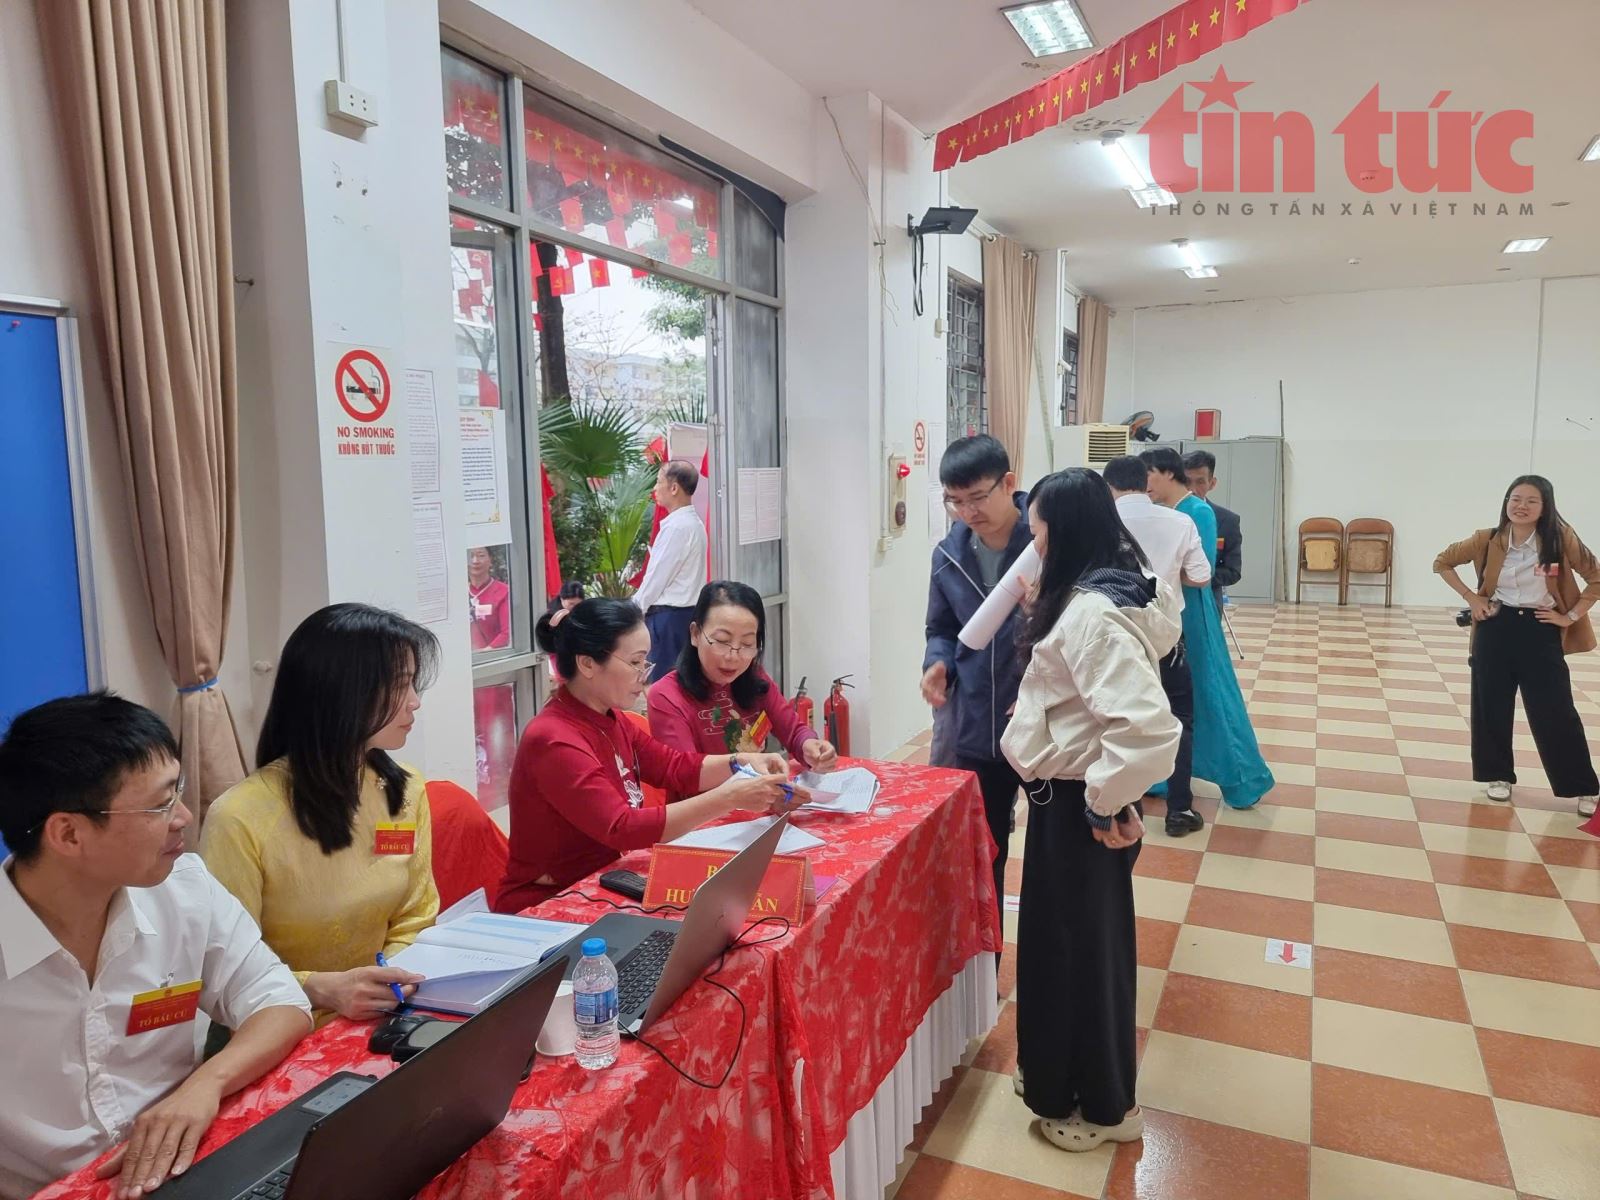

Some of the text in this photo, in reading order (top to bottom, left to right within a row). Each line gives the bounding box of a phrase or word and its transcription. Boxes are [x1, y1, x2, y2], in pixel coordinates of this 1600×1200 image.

[337, 426, 395, 439] NO SMOKING
[338, 441, 360, 455] KHÔNG
[751, 892, 779, 912] ẪN
